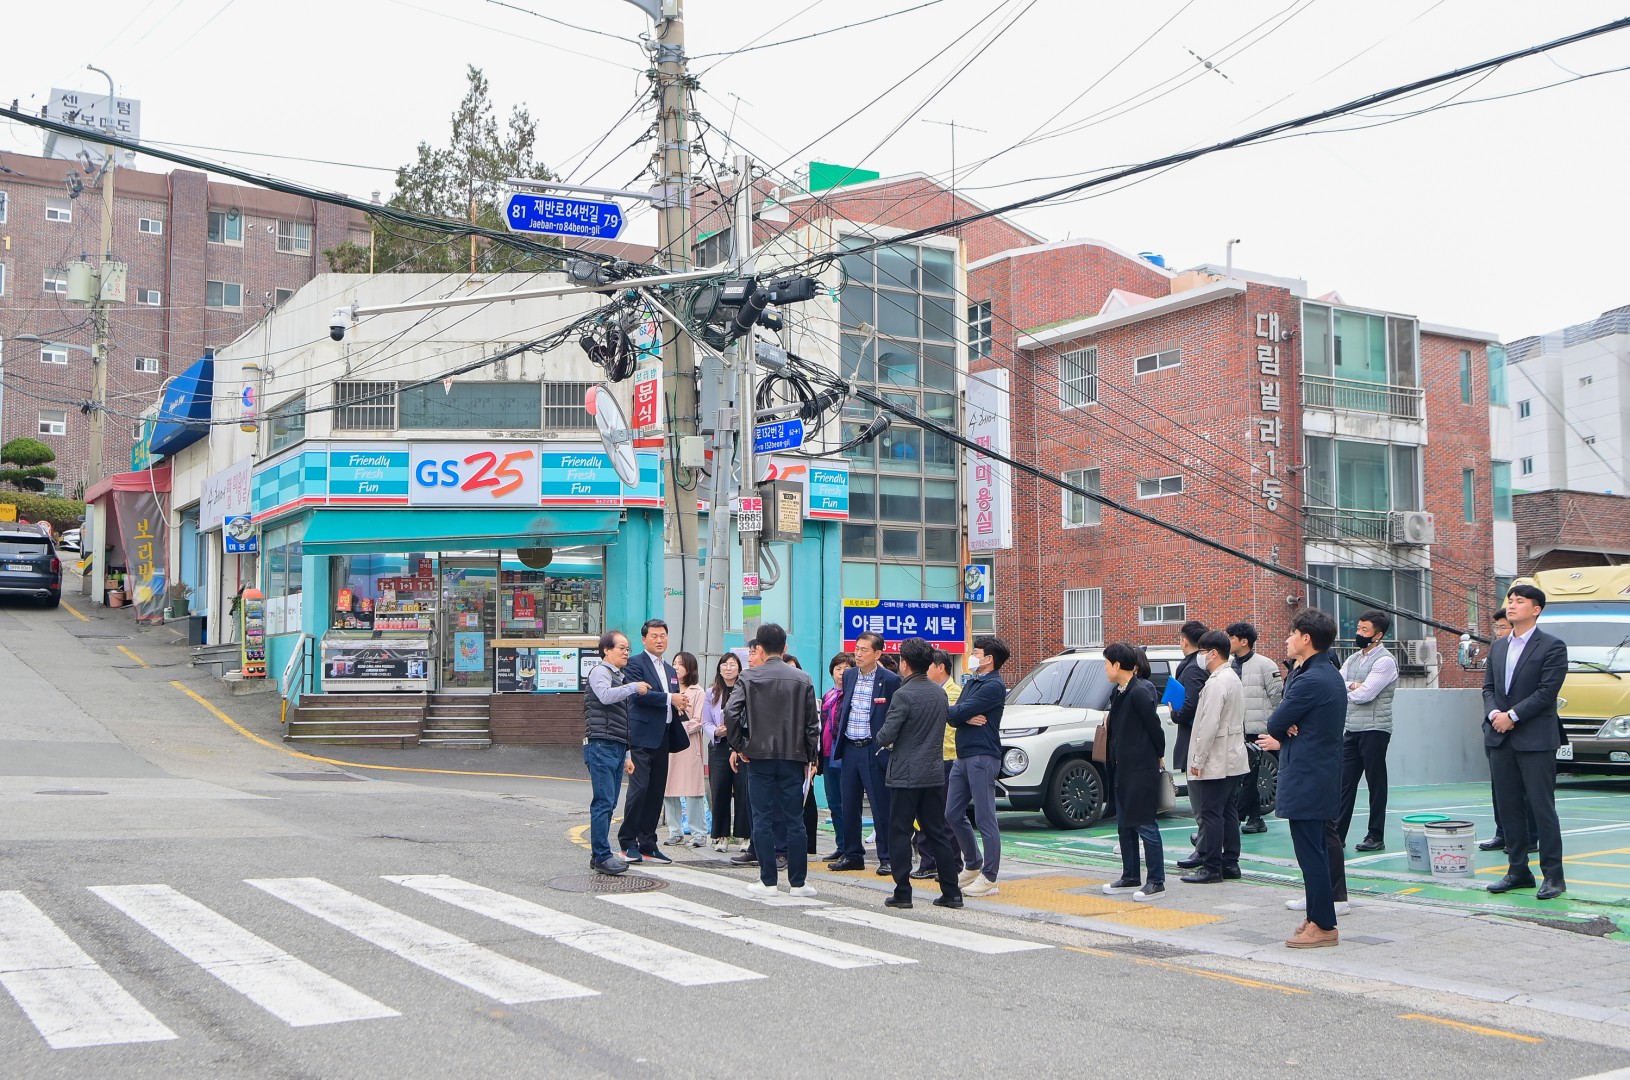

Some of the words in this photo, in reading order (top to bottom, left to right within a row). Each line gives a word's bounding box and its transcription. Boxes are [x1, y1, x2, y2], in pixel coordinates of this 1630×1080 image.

[512, 204, 526, 219] 81
[533, 199, 600, 224] 재반로84번길
[603, 214, 618, 229] 79
[636, 367, 657, 382] 보리밥
[638, 381, 654, 422] 분식
[349, 454, 390, 468] Friendly
[561, 455, 602, 468] Friendly
[354, 468, 384, 480] Fresh
[415, 450, 534, 498] GS25
[566, 469, 595, 481] Fresh
[814, 471, 846, 486] Friendly
[358, 482, 379, 494] Fun
[571, 483, 591, 495] Fun
[822, 497, 838, 509] Fun
[738, 513, 762, 522] 6685
[738, 521, 762, 531] 3344
[133, 518, 156, 582] 보리밥
[852, 615, 918, 635] 아름다운
[924, 616, 957, 635] 세탁
